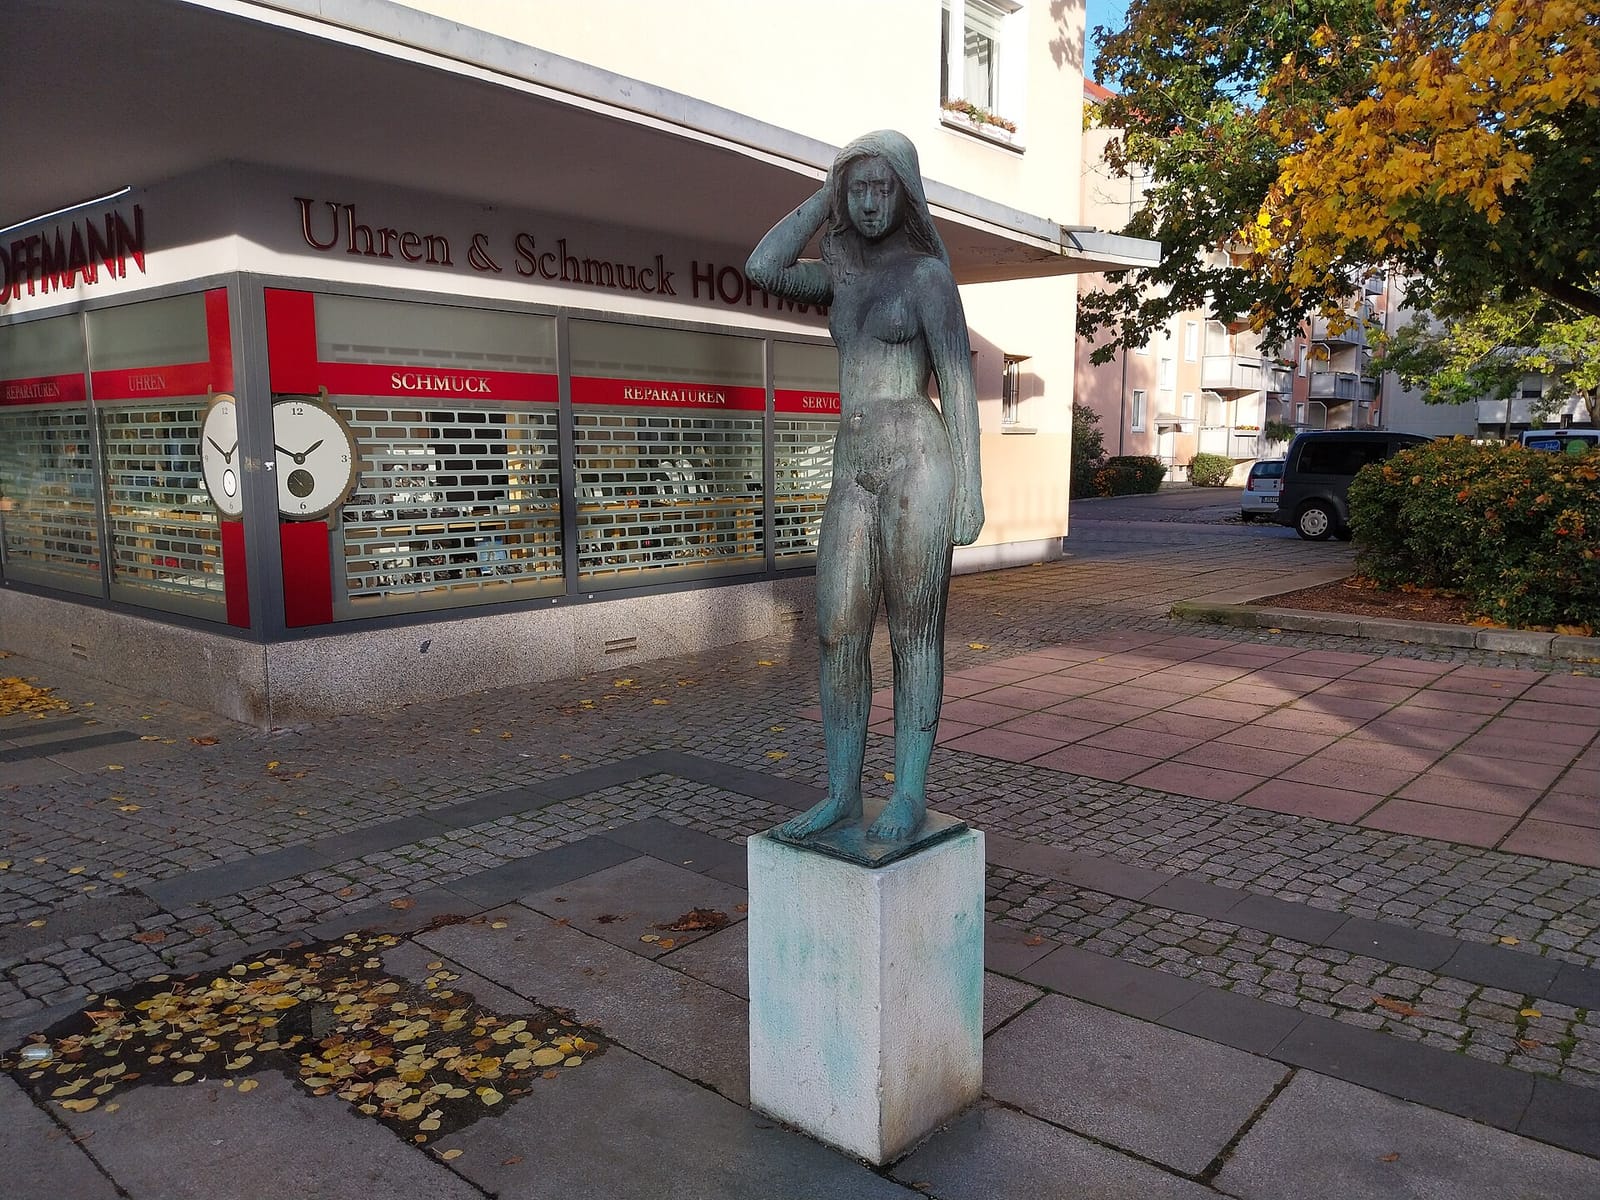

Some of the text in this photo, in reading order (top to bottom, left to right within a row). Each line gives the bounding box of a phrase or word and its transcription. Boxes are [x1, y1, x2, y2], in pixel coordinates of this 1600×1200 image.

[293, 197, 454, 268] Uhren
[467, 232, 503, 275] &
[514, 232, 678, 298] Schmuck
[127, 374, 166, 392] UHREN
[390, 372, 492, 393] SCHMUCK
[6, 383, 61, 400] REPARATUREN
[623, 386, 726, 404] REPARATUREN
[222, 407, 228, 415] 12
[291, 407, 303, 415] 12
[341, 455, 348, 463] 3
[300, 502, 307, 510] 6
